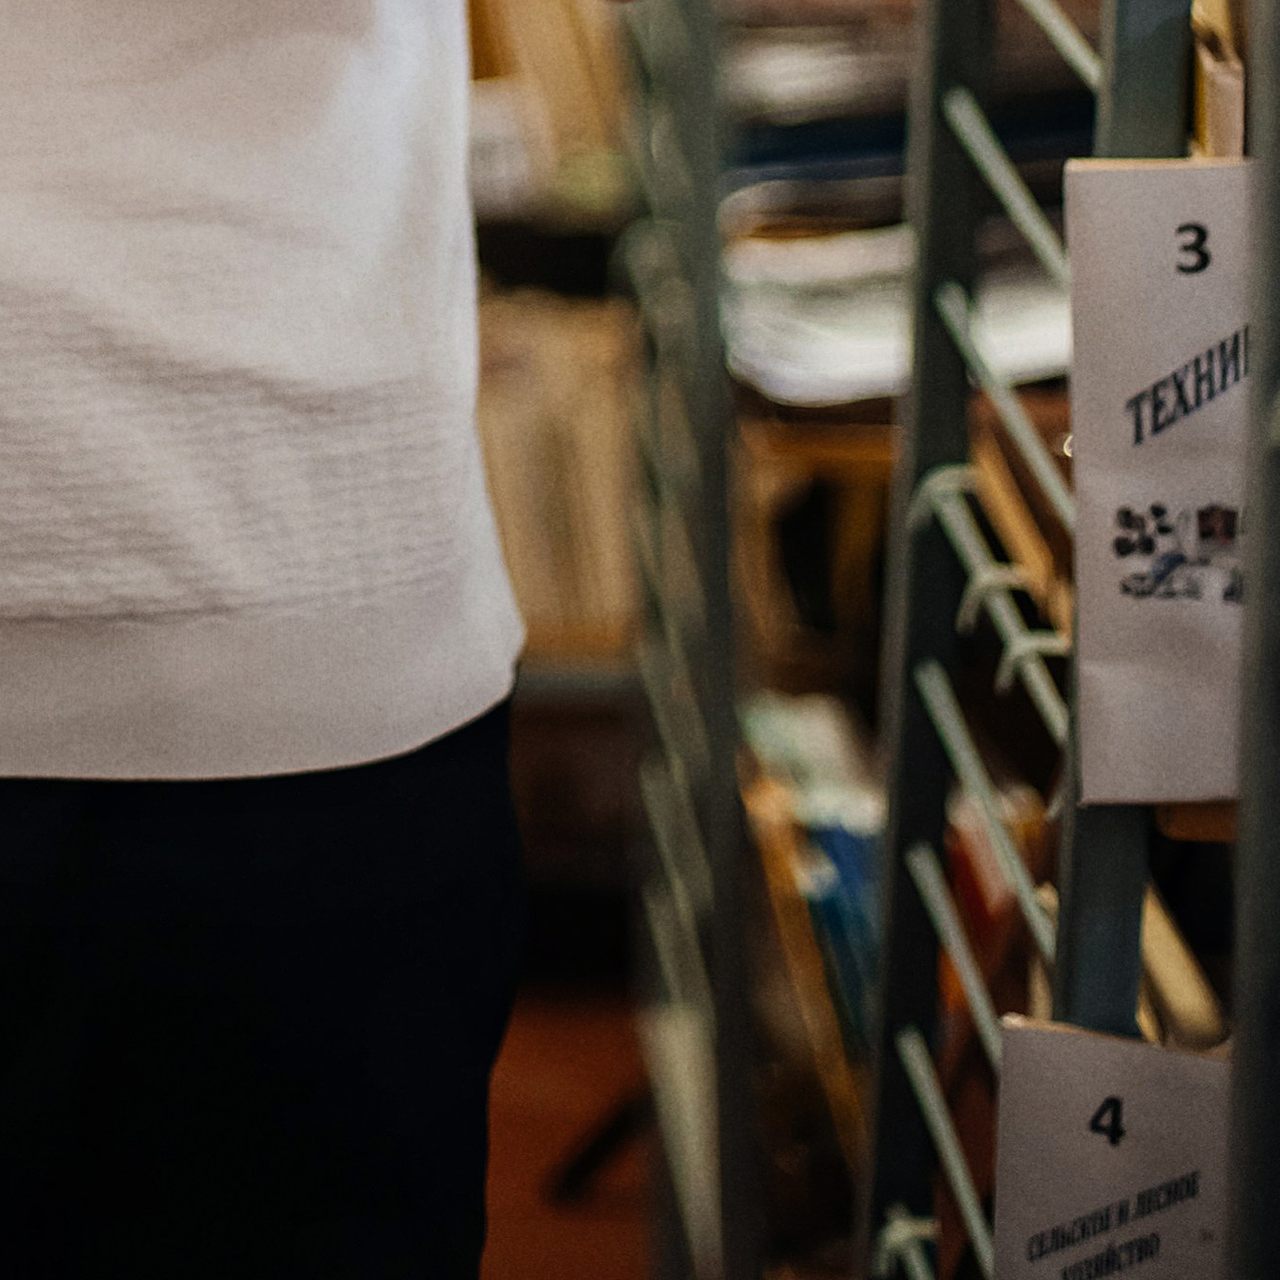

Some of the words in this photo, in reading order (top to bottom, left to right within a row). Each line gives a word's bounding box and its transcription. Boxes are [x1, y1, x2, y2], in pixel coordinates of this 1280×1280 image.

[1175, 222, 1212, 274] 3
[1126, 324, 1249, 445] ТЕХНИ
[1088, 1095, 1125, 1146] 4
